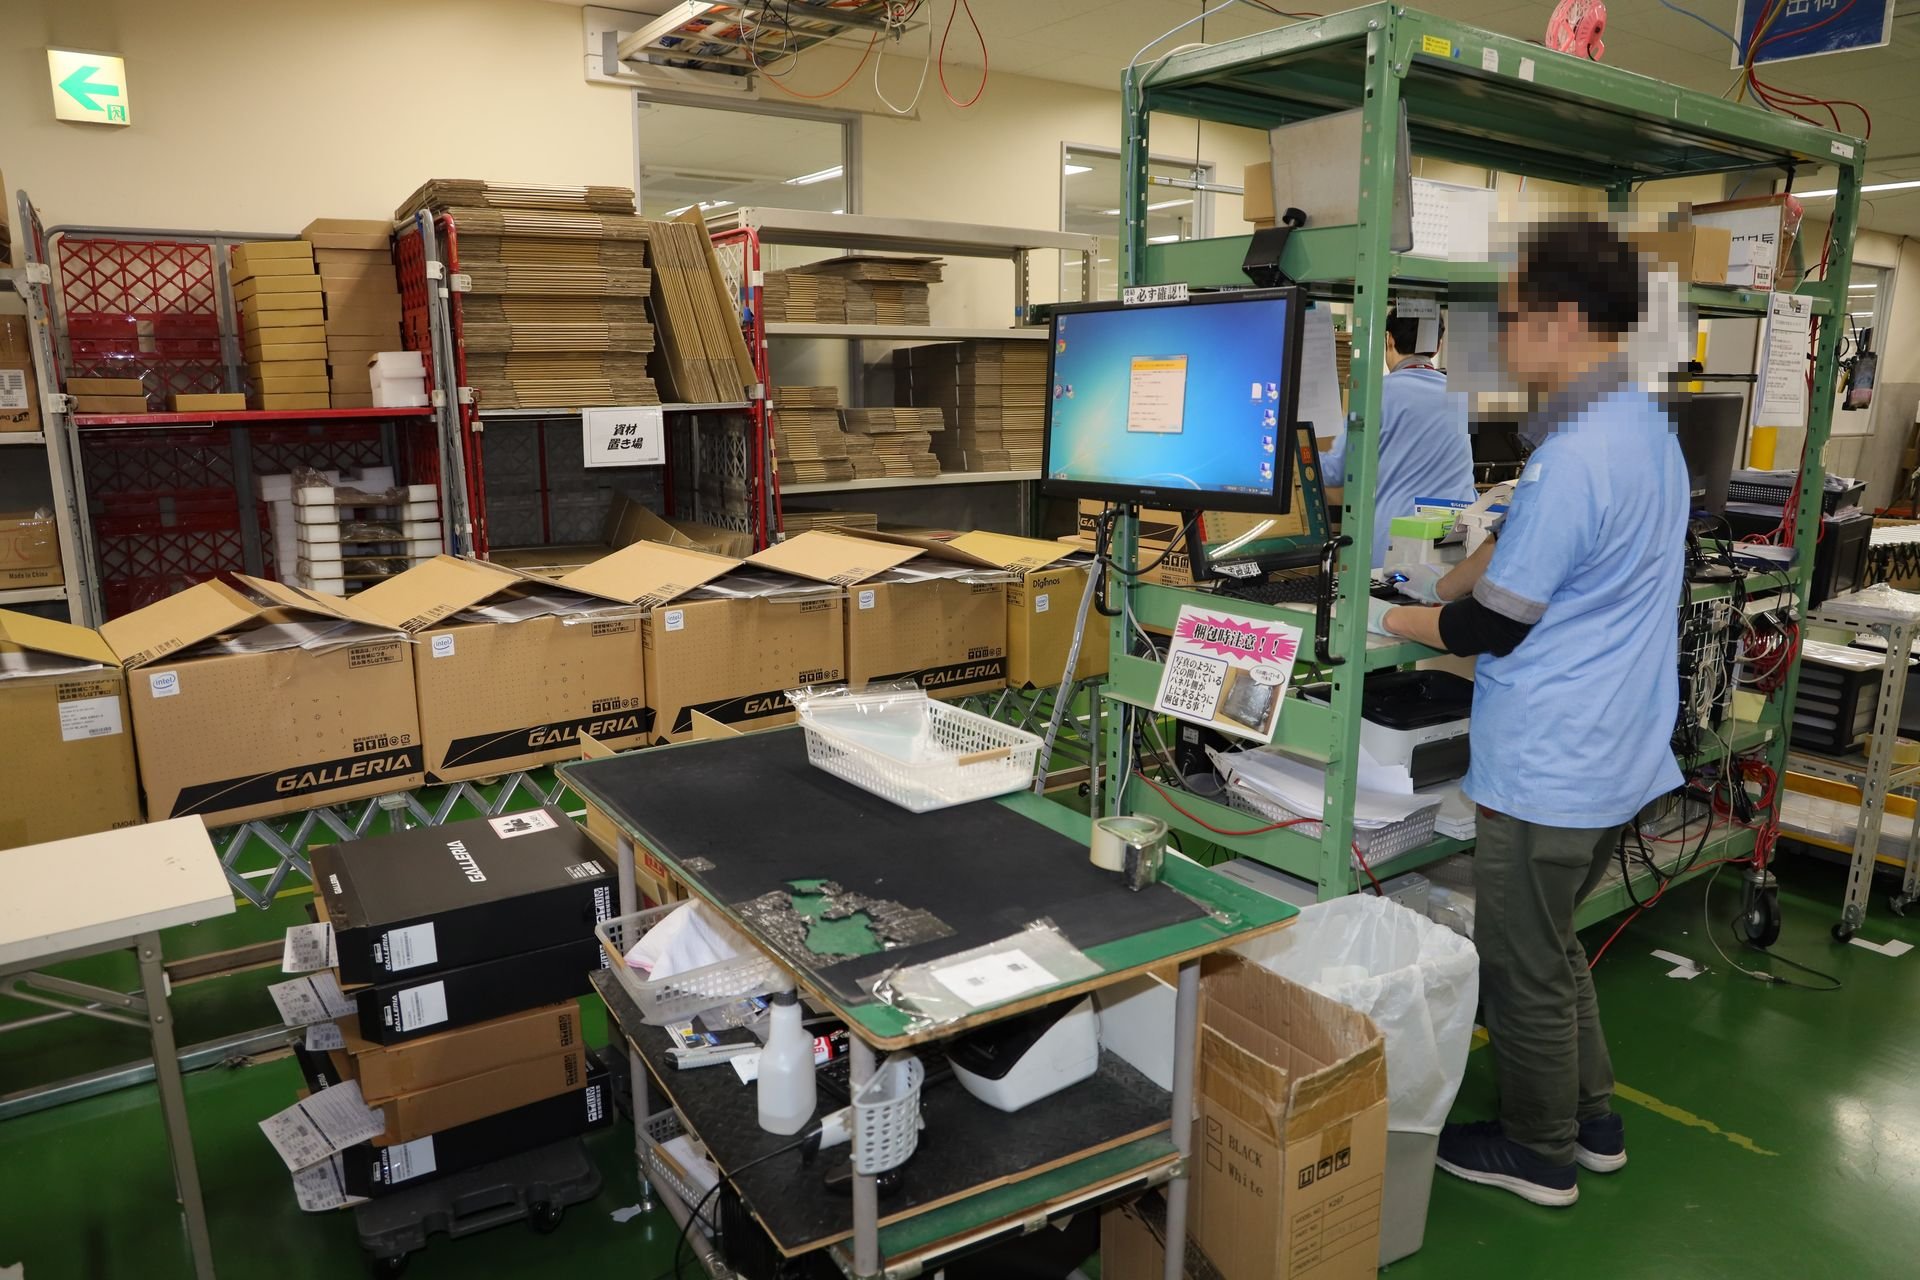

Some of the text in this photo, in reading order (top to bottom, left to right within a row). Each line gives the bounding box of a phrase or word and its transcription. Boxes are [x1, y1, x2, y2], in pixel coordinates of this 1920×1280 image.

[613, 423, 637, 436] 資材
[607, 437, 643, 450] 置き場
[1194, 623, 1279, 655] 梱包時注意！！
[922, 663, 1000, 686] GALLERIA
[1172, 665, 1222, 686] 穴の開いている
[1175, 656, 1216, 674] 写真のように
[155, 676, 173, 686] intel
[1170, 676, 1205, 691] パネル側が
[1168, 685, 1214, 705] 上に来るように
[528, 715, 639, 747] GALLERIA
[276, 754, 412, 793] GALLERIA
[446, 840, 487, 882] GALLERIA
[382, 933, 392, 971] GALLERIA
[392, 994, 401, 1032] GALLERIA
[318, 1073, 329, 1090] LERIA
[1228, 1134, 1263, 1168] BLACK
[1228, 1162, 1264, 1197] White
